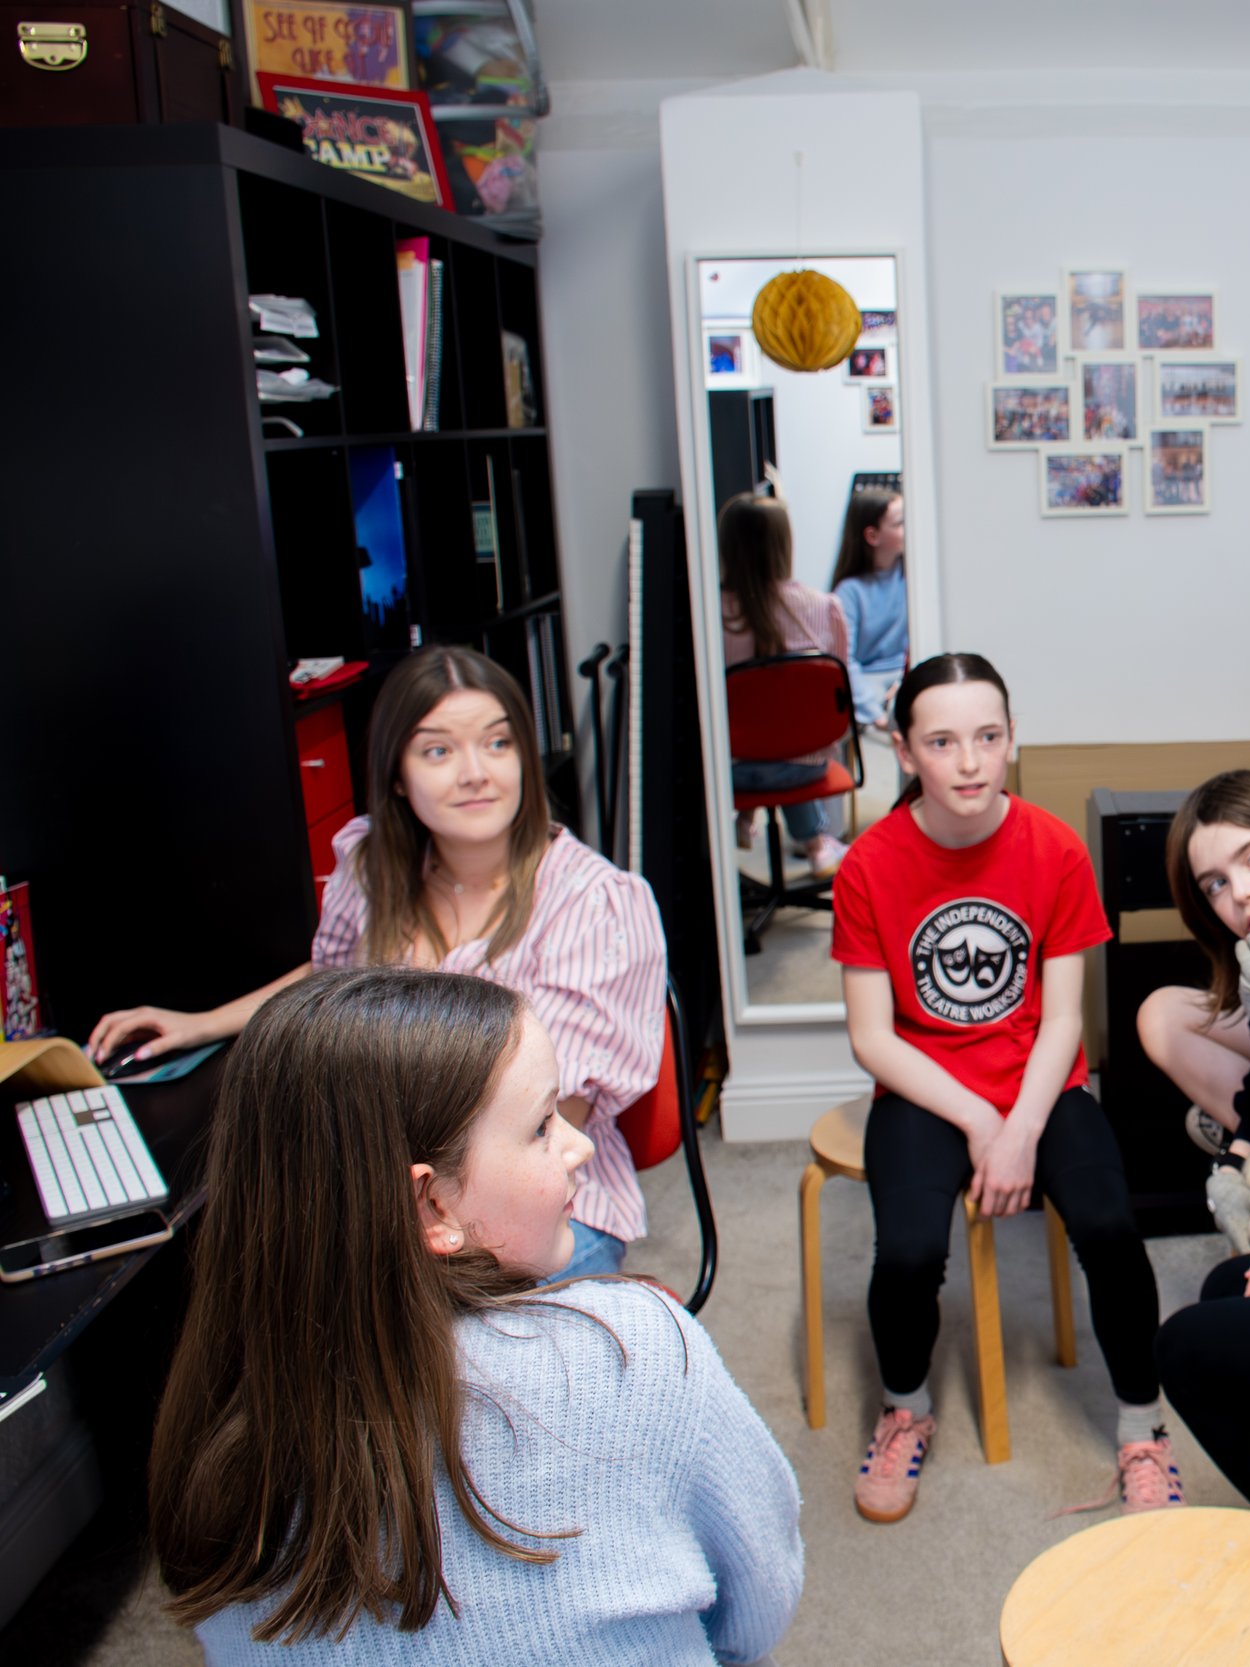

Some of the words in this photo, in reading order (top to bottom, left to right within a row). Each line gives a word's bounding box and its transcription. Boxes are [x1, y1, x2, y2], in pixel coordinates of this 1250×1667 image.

[263, 11, 297, 43] SEE
[916, 925, 940, 957] THE
[934, 905, 1028, 947] INDEPENDENT
[917, 974, 969, 1021] THEATRE
[968, 962, 1028, 1021] WORKSHOP
